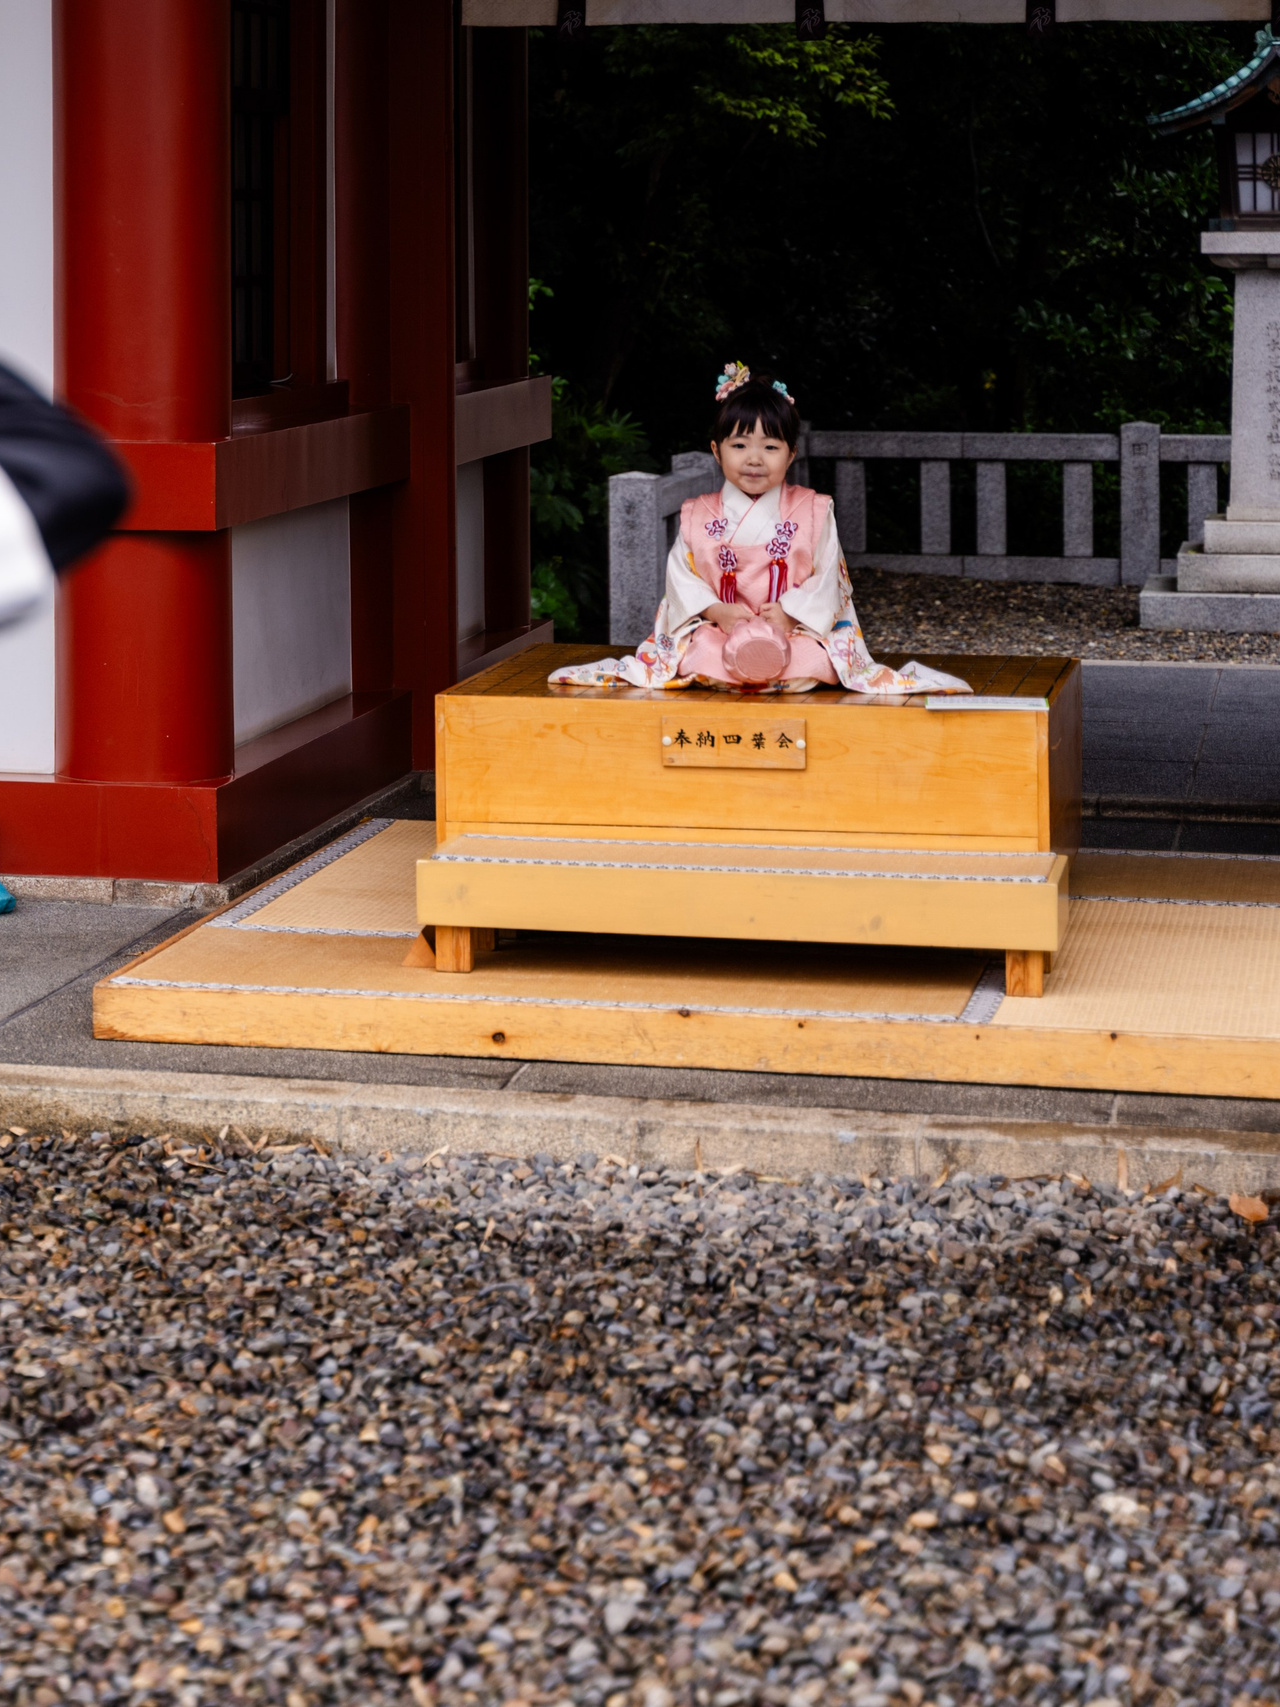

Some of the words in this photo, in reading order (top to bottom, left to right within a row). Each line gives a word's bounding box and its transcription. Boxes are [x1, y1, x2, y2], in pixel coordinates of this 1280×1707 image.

[673, 728, 794, 750] 奉納四葉会
